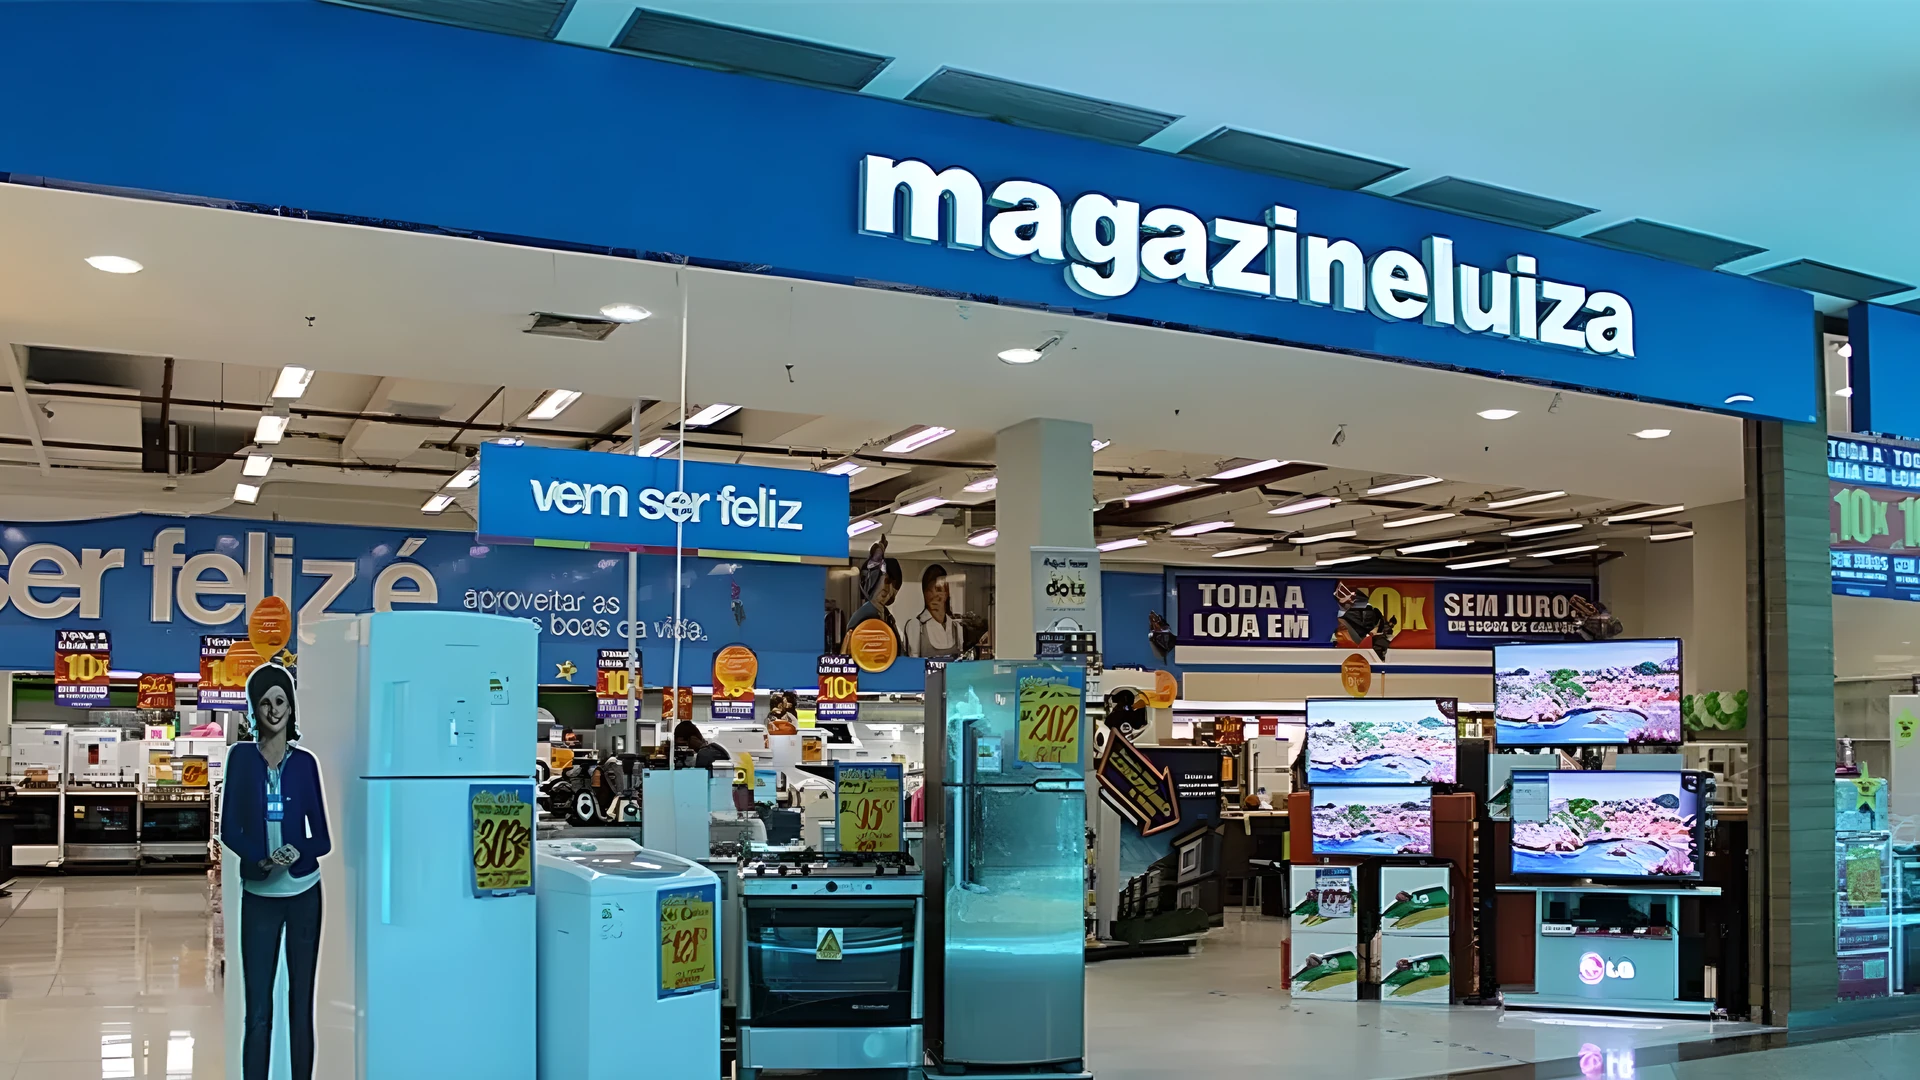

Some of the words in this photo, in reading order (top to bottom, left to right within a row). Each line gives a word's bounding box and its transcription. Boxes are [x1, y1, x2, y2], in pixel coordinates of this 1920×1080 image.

[858, 153, 1637, 359] magazineluiza
[530, 478, 629, 518] vem
[639, 486, 711, 524] ser
[716, 485, 804, 531] feliz
[463, 588, 586, 614] aproveitar
[592, 595, 621, 615] as
[1198, 584, 1279, 608] TODA
[1284, 586, 1305, 608] A
[1444, 593, 1498, 617] SEM
[1504, 594, 1578, 619] JURO
[1193, 613, 1260, 638] LOJA
[1267, 614, 1309, 639] EM
